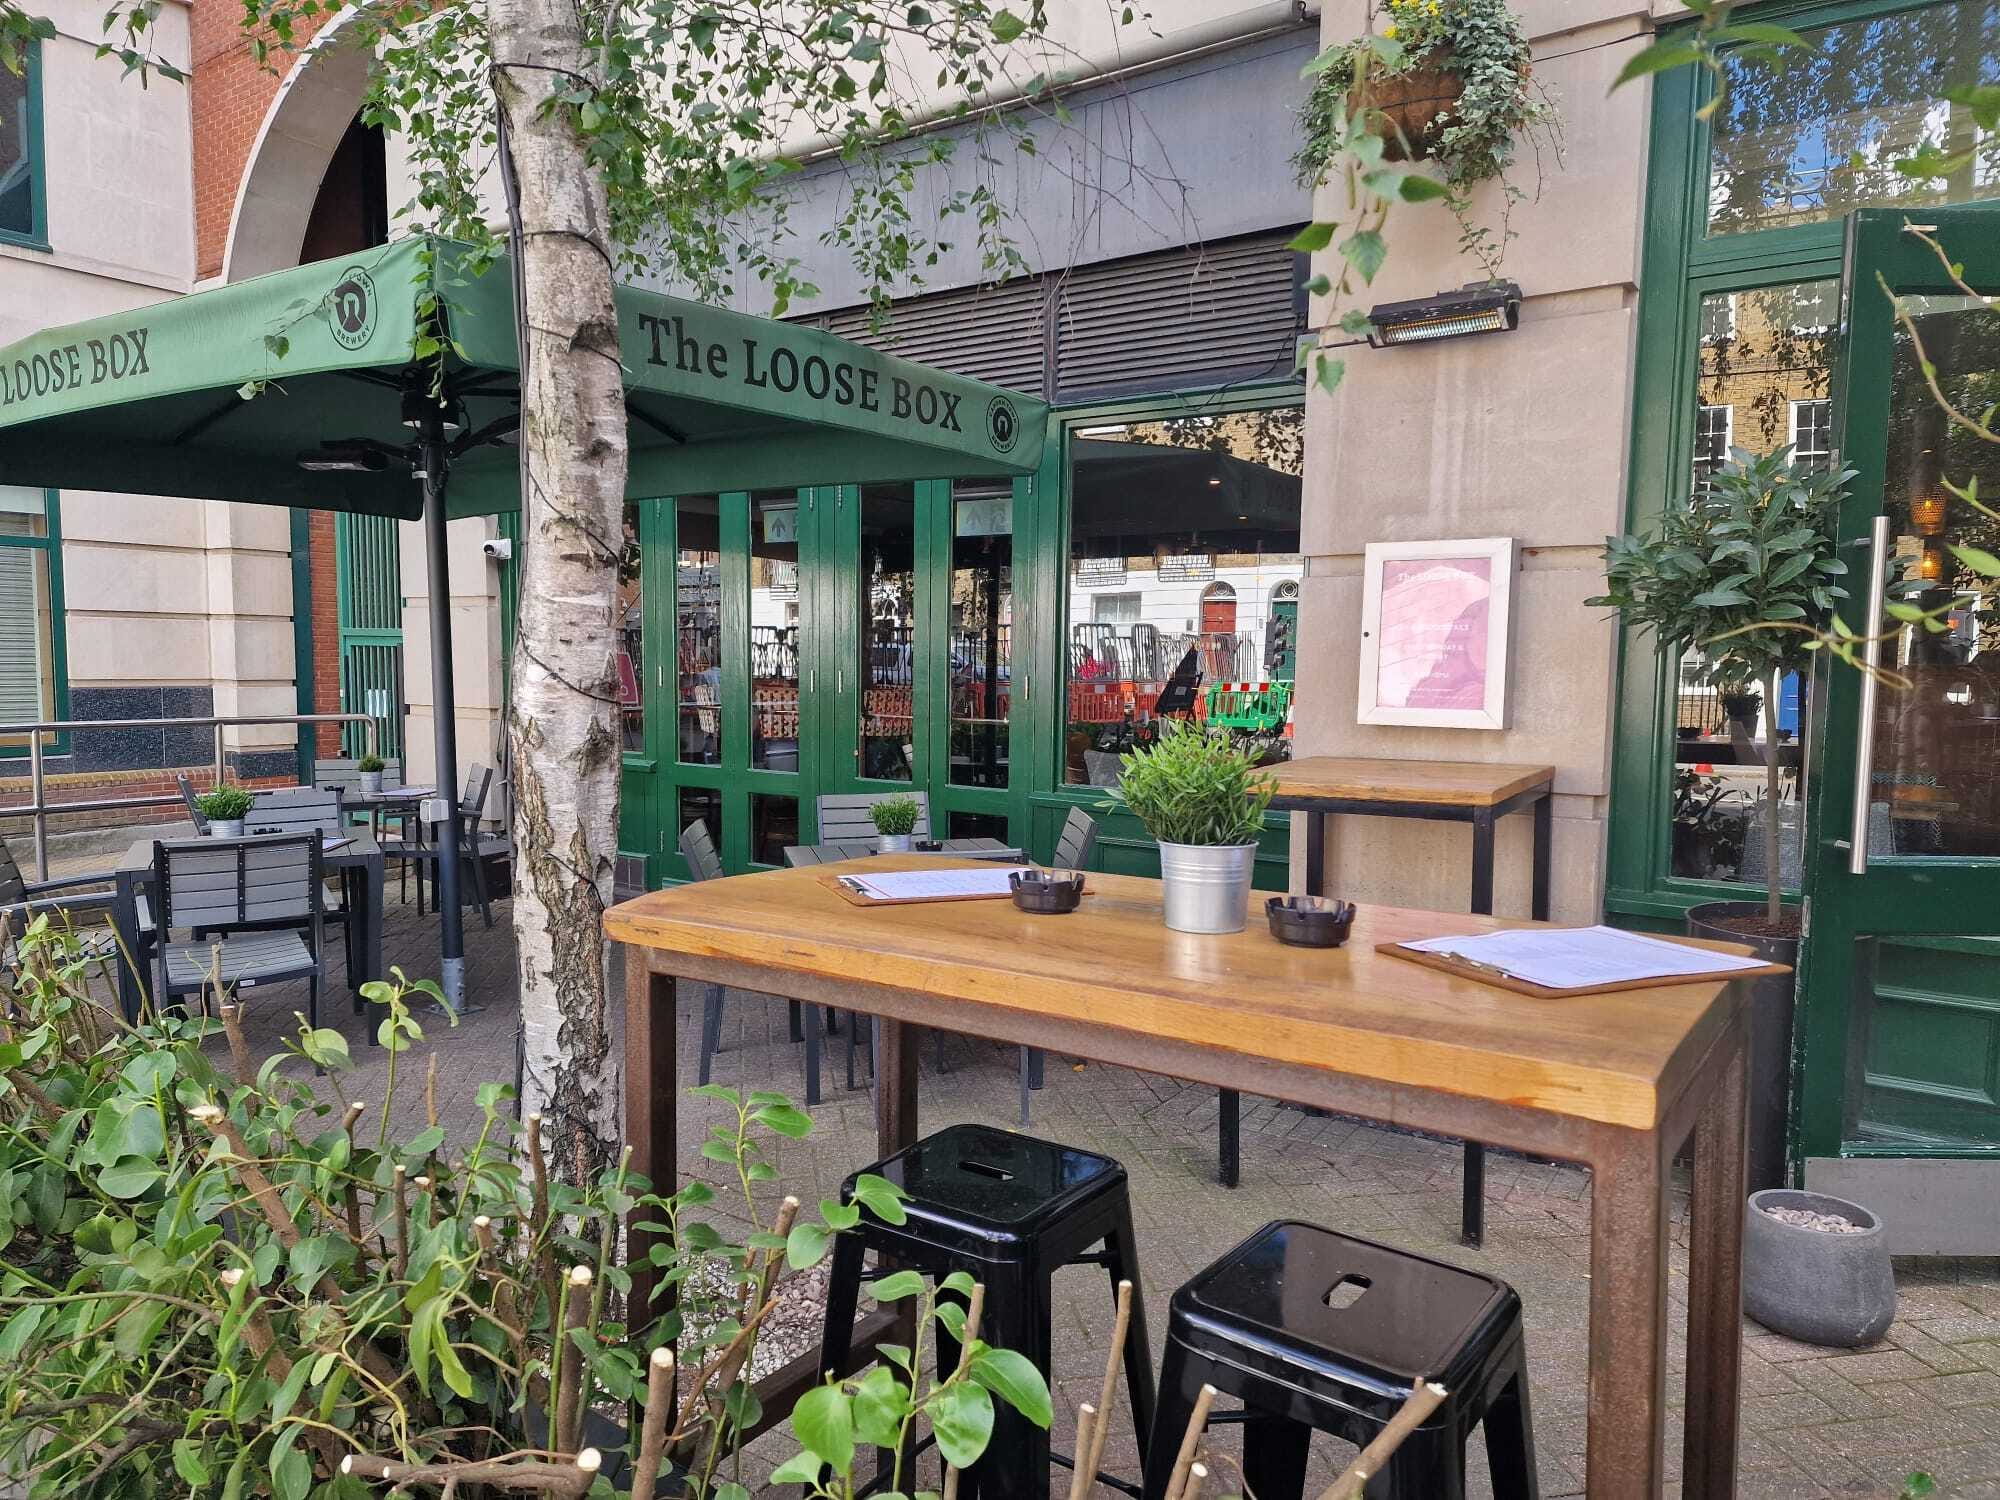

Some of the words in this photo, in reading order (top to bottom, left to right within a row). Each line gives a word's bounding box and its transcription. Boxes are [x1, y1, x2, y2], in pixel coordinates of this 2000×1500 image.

[0, 345, 82, 406] LOOSE
[86, 328, 150, 385] BOX
[337, 325, 370, 345] BREWERY
[639, 312, 728, 378] The
[743, 339, 879, 412] LOOSE
[891, 377, 962, 433] BOX
